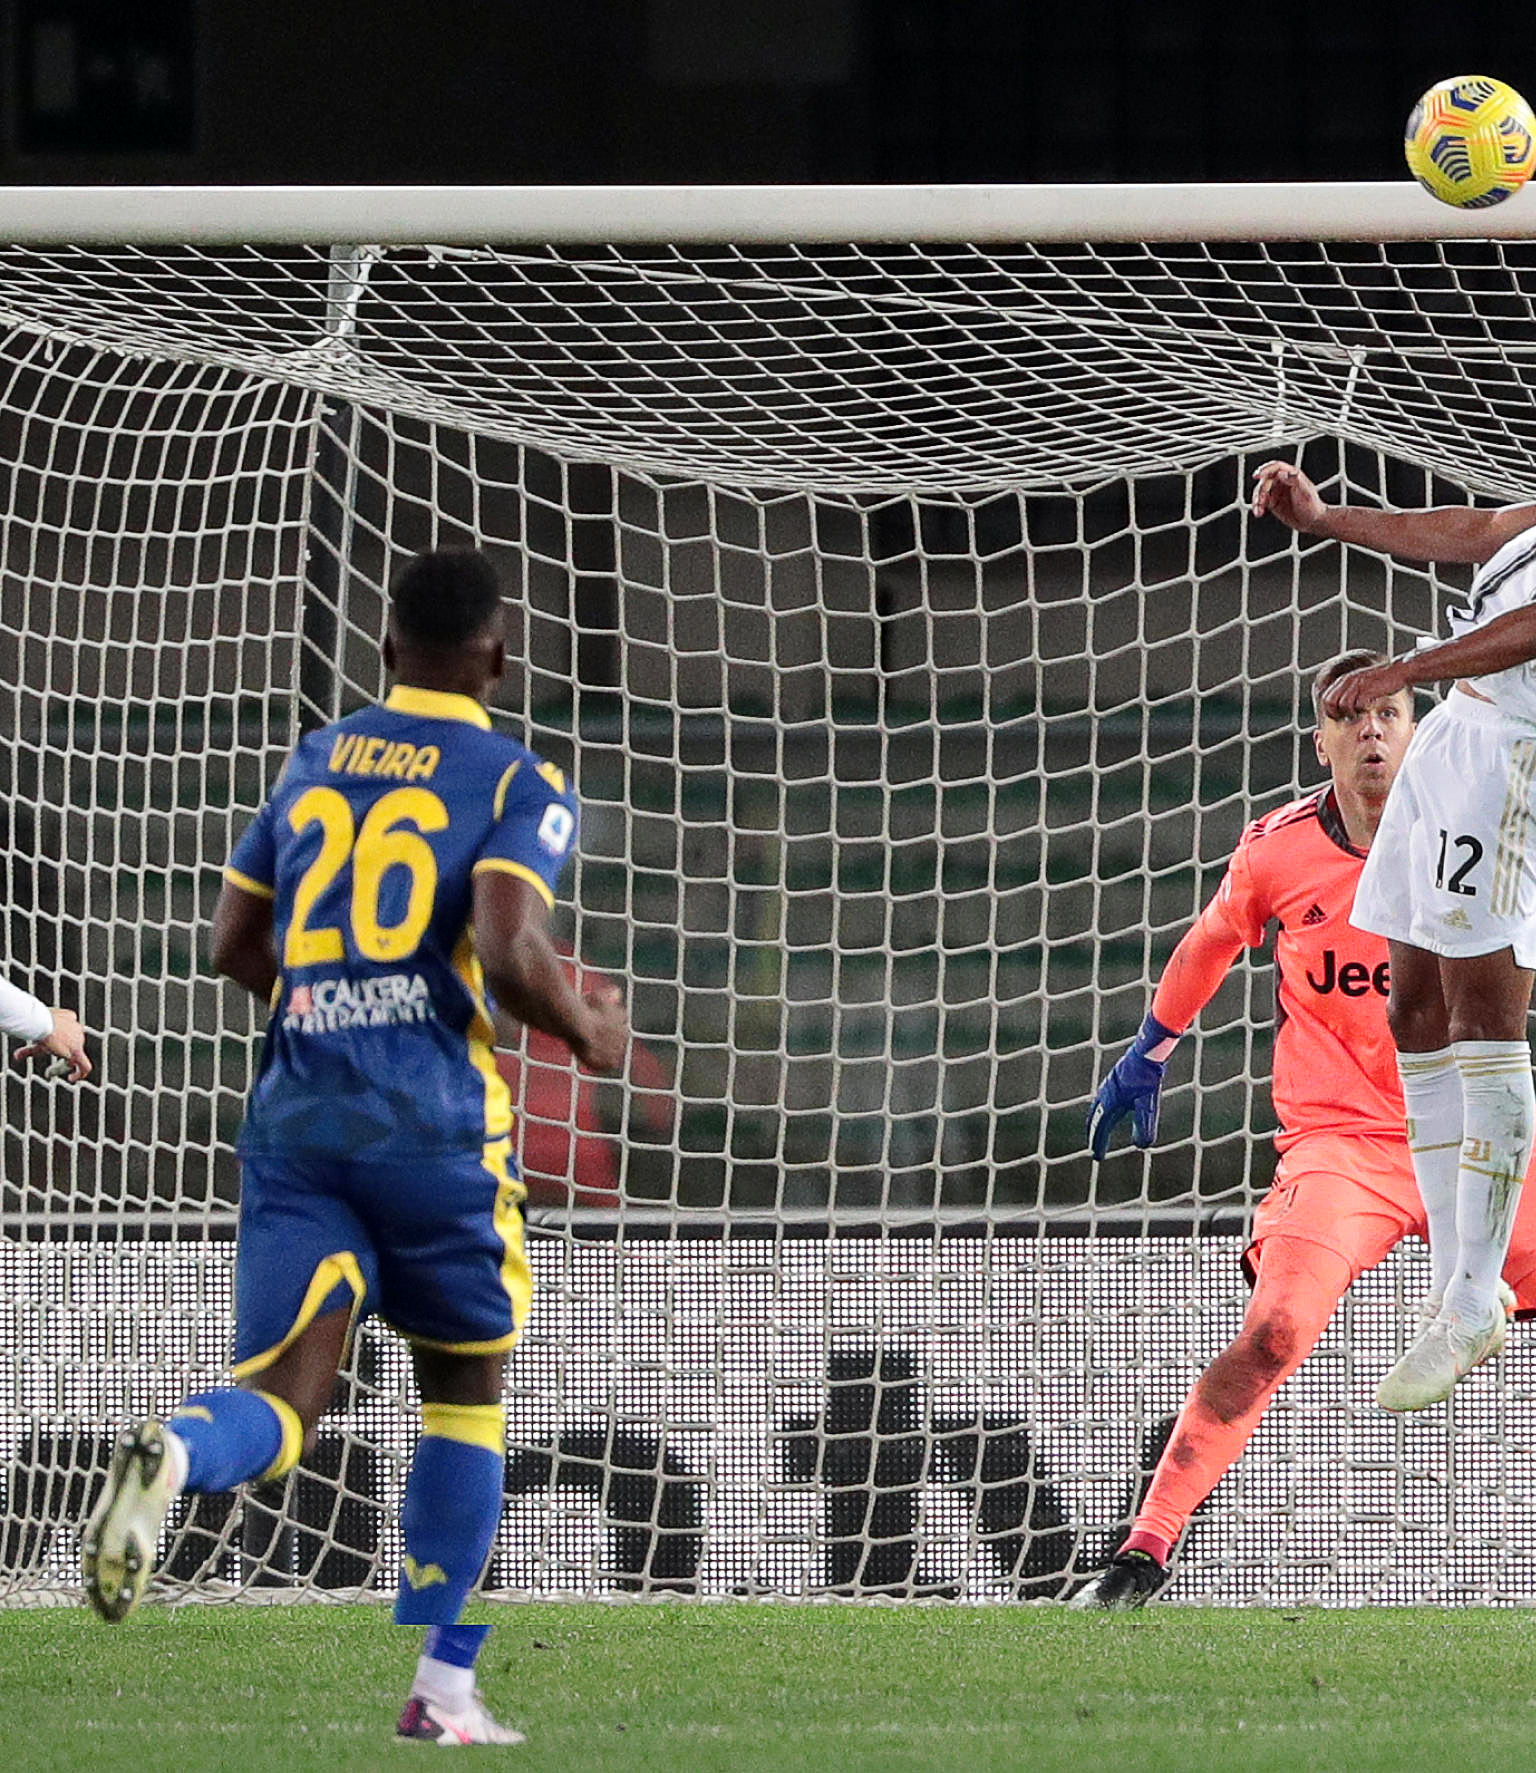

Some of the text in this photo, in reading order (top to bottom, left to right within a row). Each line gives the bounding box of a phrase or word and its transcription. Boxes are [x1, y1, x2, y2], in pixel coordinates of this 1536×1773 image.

[328, 732, 441, 781] VIEIRA
[283, 786, 450, 968] 26
[1436, 829, 1483, 896] 12
[1305, 950, 1390, 997] Jee
